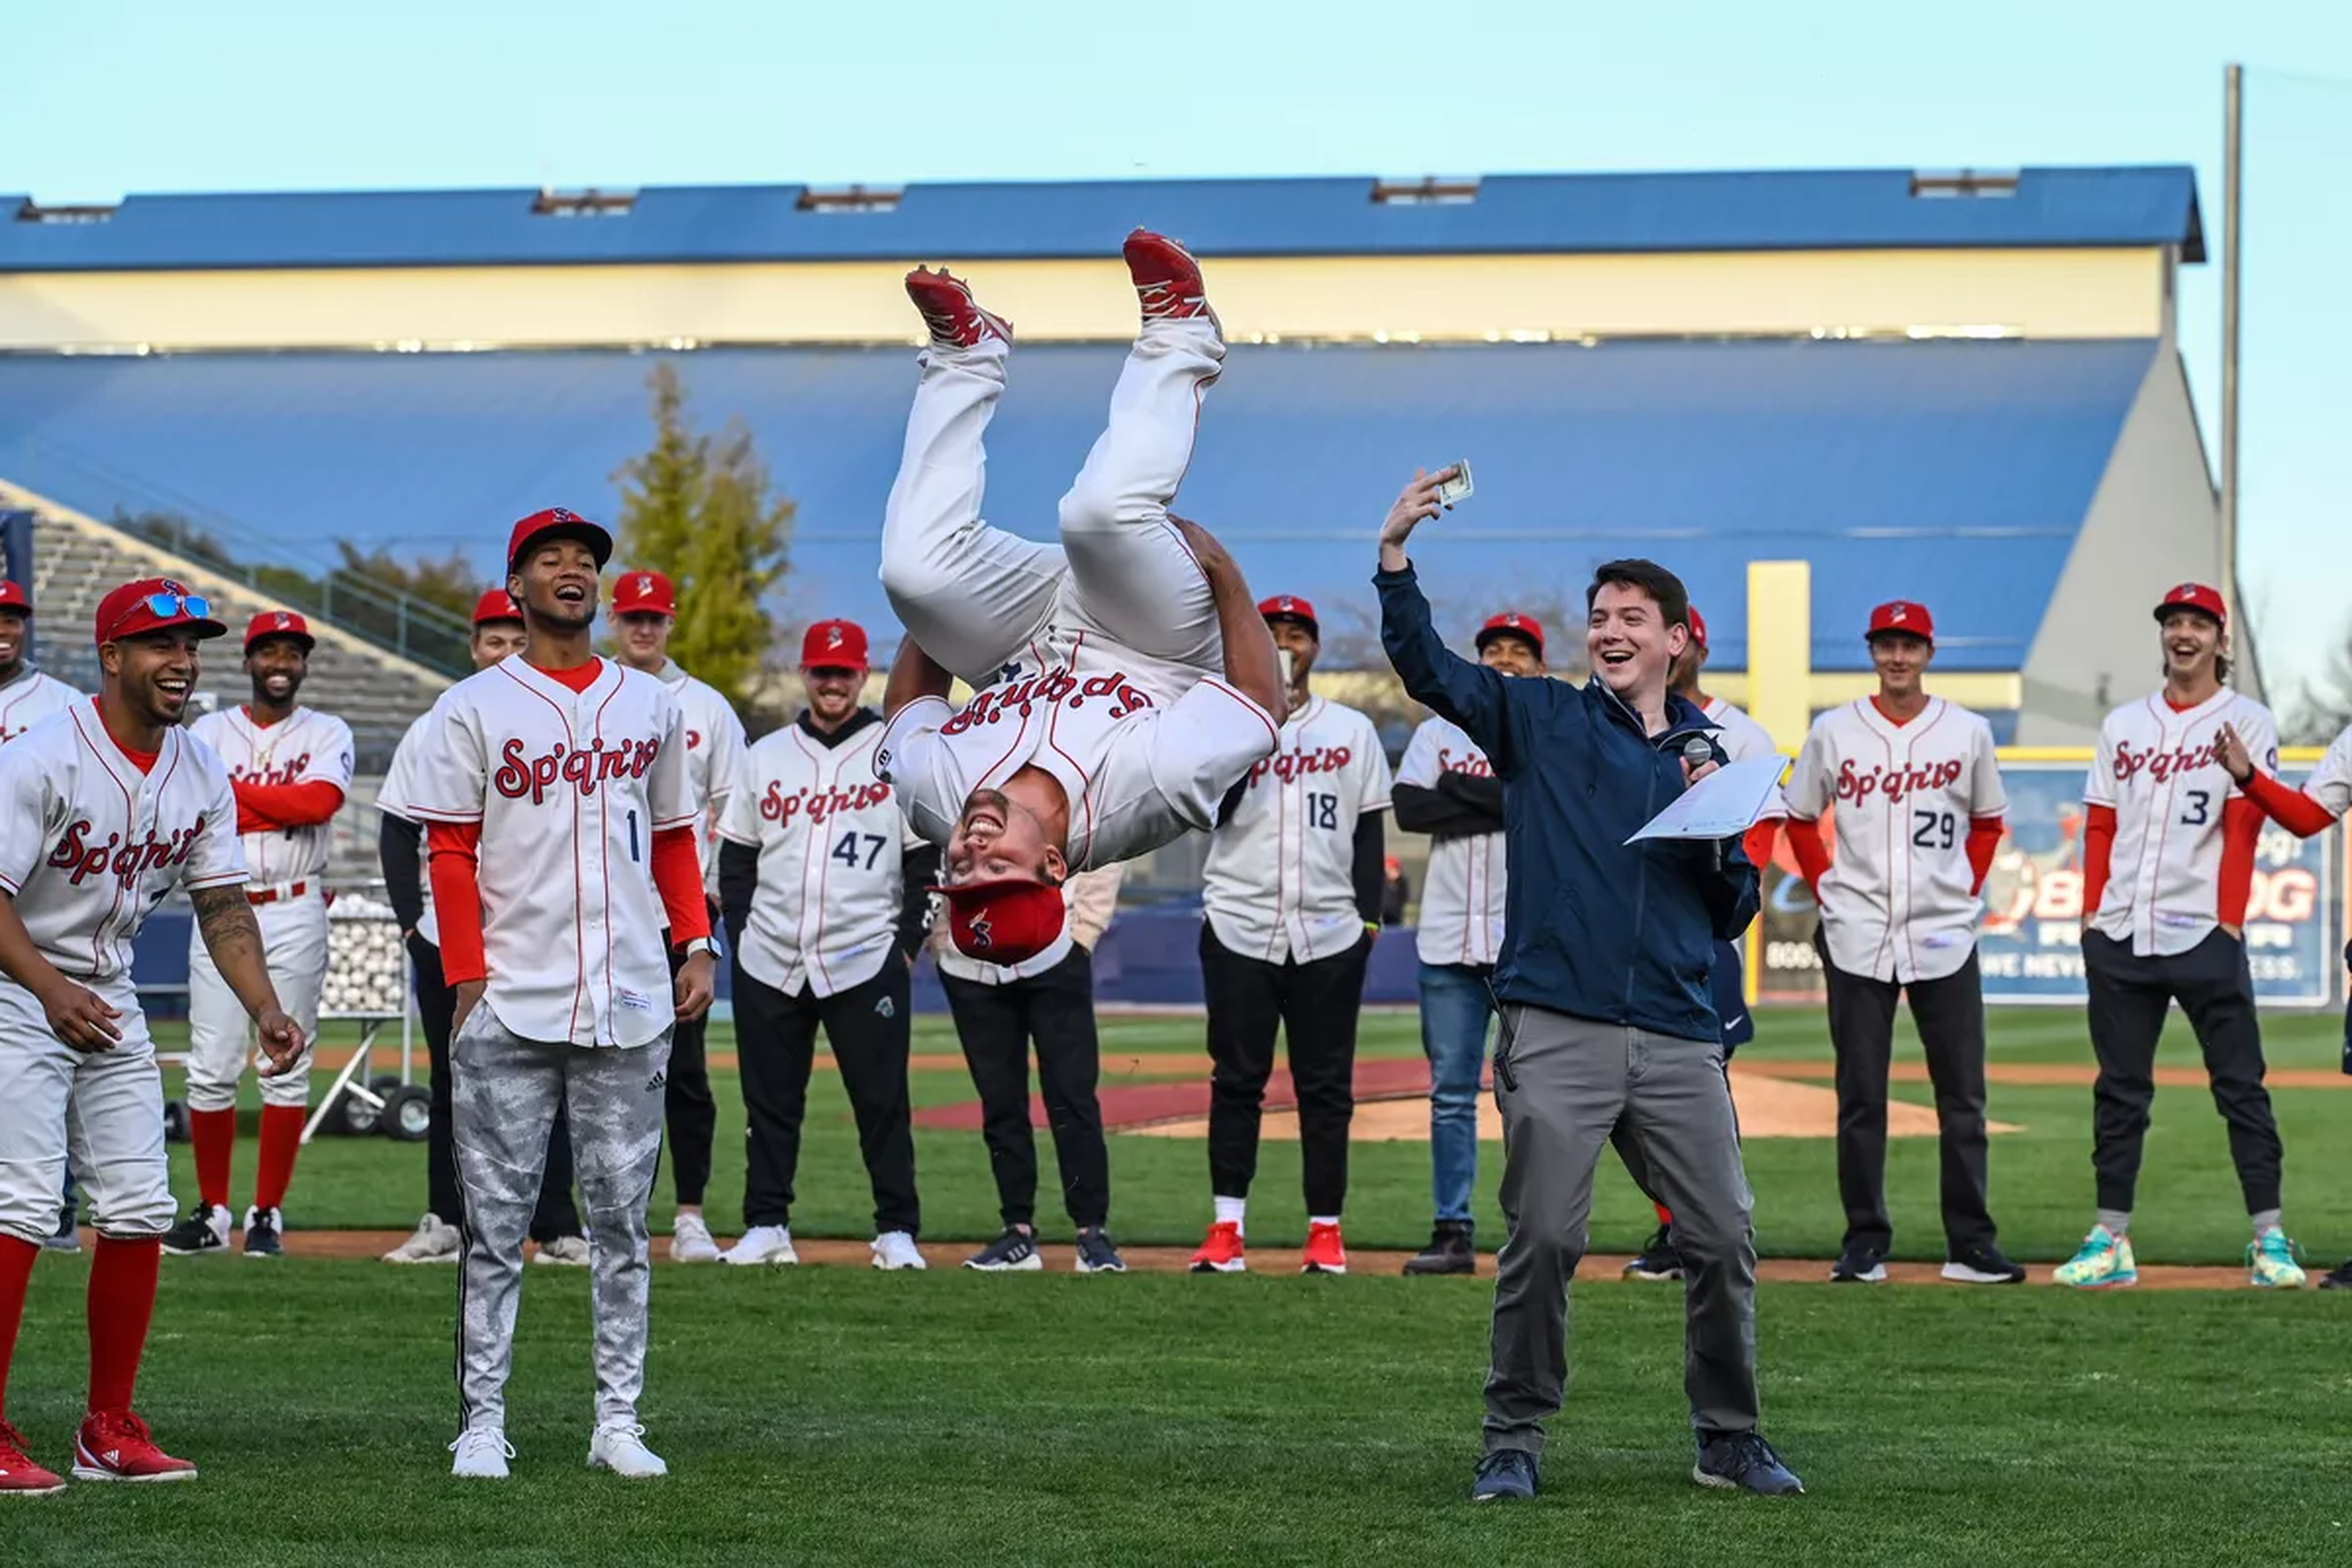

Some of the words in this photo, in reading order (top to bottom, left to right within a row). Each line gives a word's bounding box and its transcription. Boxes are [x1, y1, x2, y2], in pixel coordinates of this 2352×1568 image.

[1307, 792, 1338, 831] 18
[2182, 790, 2209, 825] 3
[627, 809, 640, 863] 1
[1913, 810, 1956, 849] 29
[832, 831, 887, 870] 47
